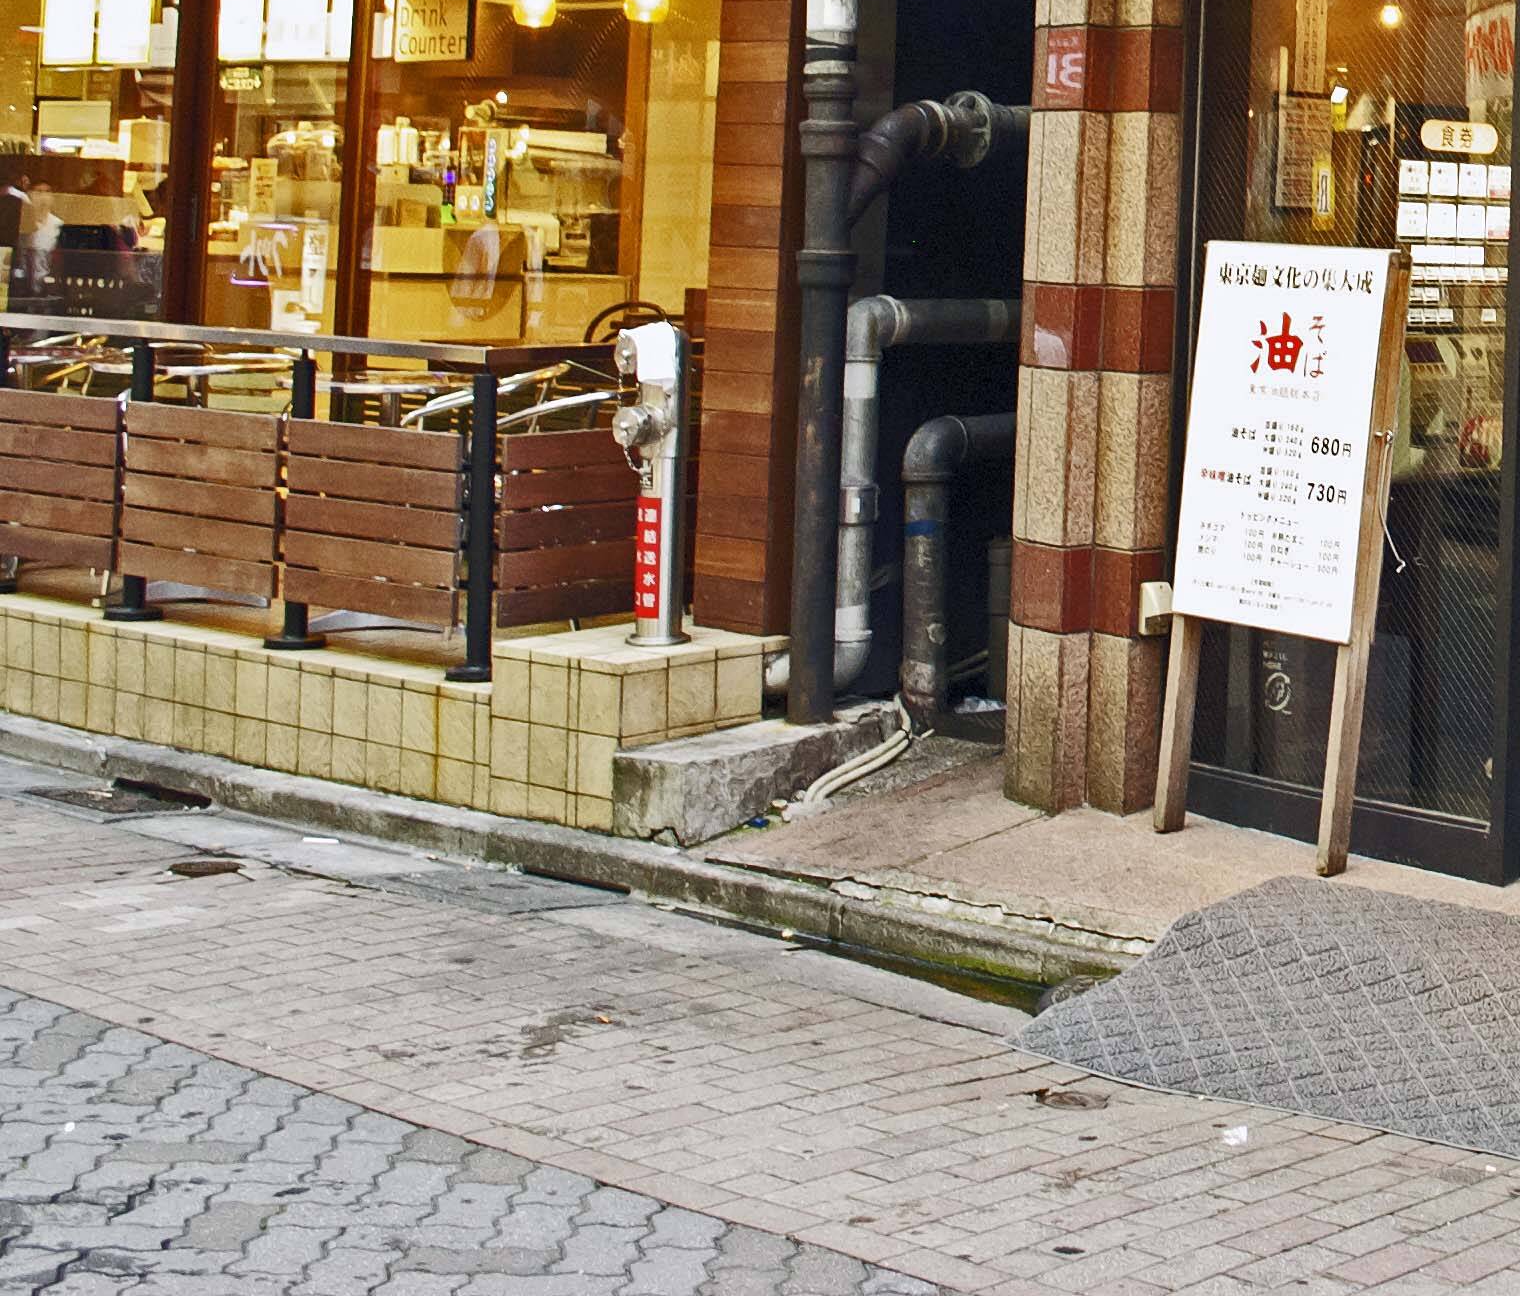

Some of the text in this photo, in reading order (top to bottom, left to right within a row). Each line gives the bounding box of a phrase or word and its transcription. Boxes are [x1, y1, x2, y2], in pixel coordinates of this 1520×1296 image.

[400, 0, 447, 27] Drink
[399, 33, 466, 55] Counter
[1311, 436, 1352, 458] 680円
[1306, 482, 1347, 505] 730円
